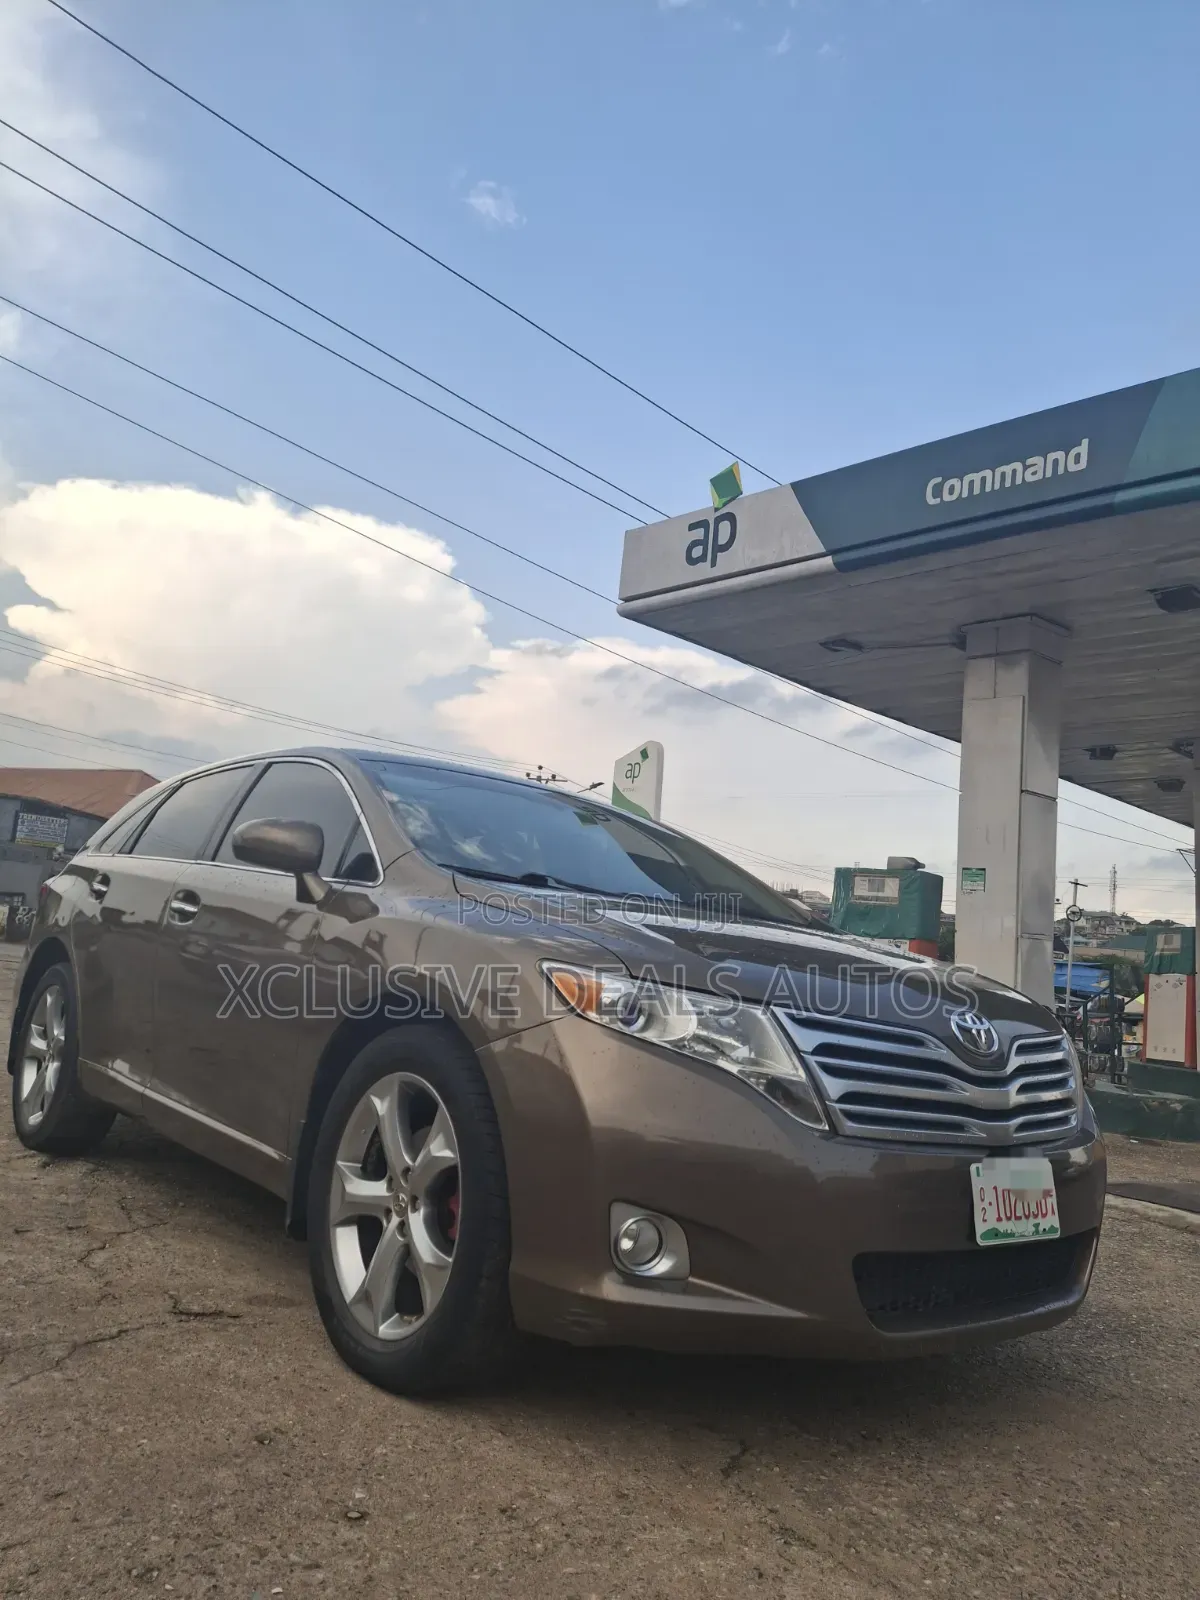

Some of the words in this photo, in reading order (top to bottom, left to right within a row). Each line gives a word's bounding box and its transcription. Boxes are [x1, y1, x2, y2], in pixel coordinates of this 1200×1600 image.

[925, 438, 1089, 506] Command
[685, 511, 738, 569] ap
[625, 762, 641, 784] ap
